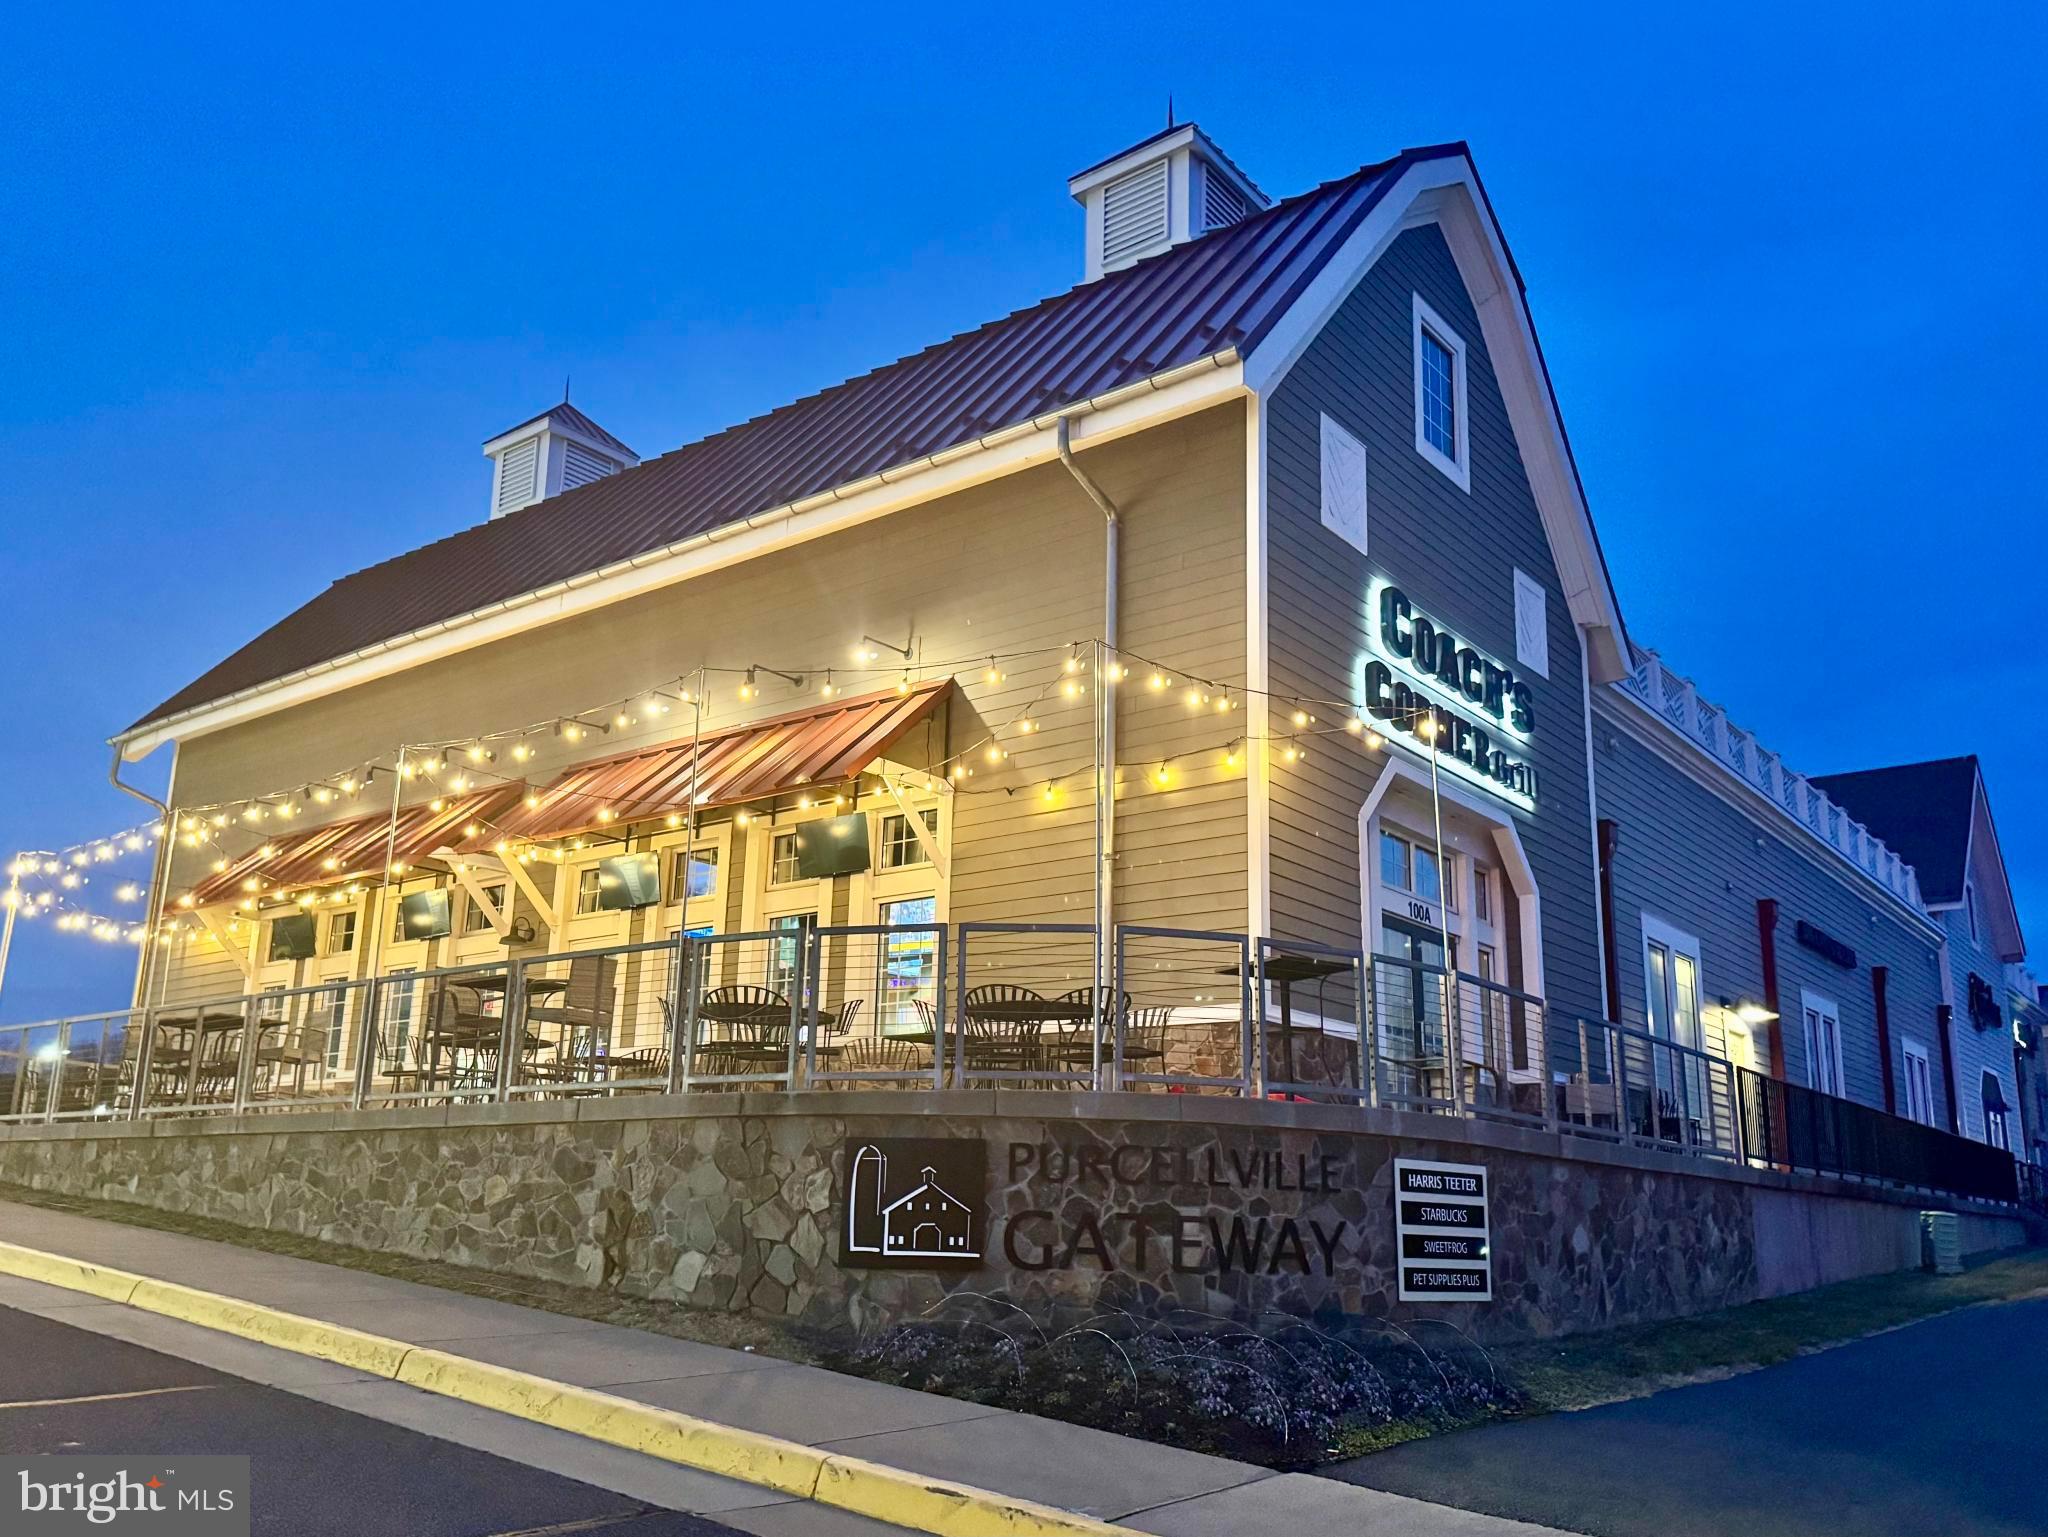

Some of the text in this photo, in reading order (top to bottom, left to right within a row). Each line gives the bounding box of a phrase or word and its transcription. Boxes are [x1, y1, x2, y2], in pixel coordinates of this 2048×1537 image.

[1408, 901, 1431, 923] 100A
[1008, 1142, 1342, 1193] PURCELLVILLE
[1408, 1174, 1477, 1191] HARRIS TEETER
[1421, 1208, 1467, 1222] STARBUCKS
[1004, 1209, 1346, 1277] GATEWAY
[1424, 1241, 1467, 1253] SWEETFROG
[1413, 1273, 1480, 1286] PET SUPPLIES PLUS
